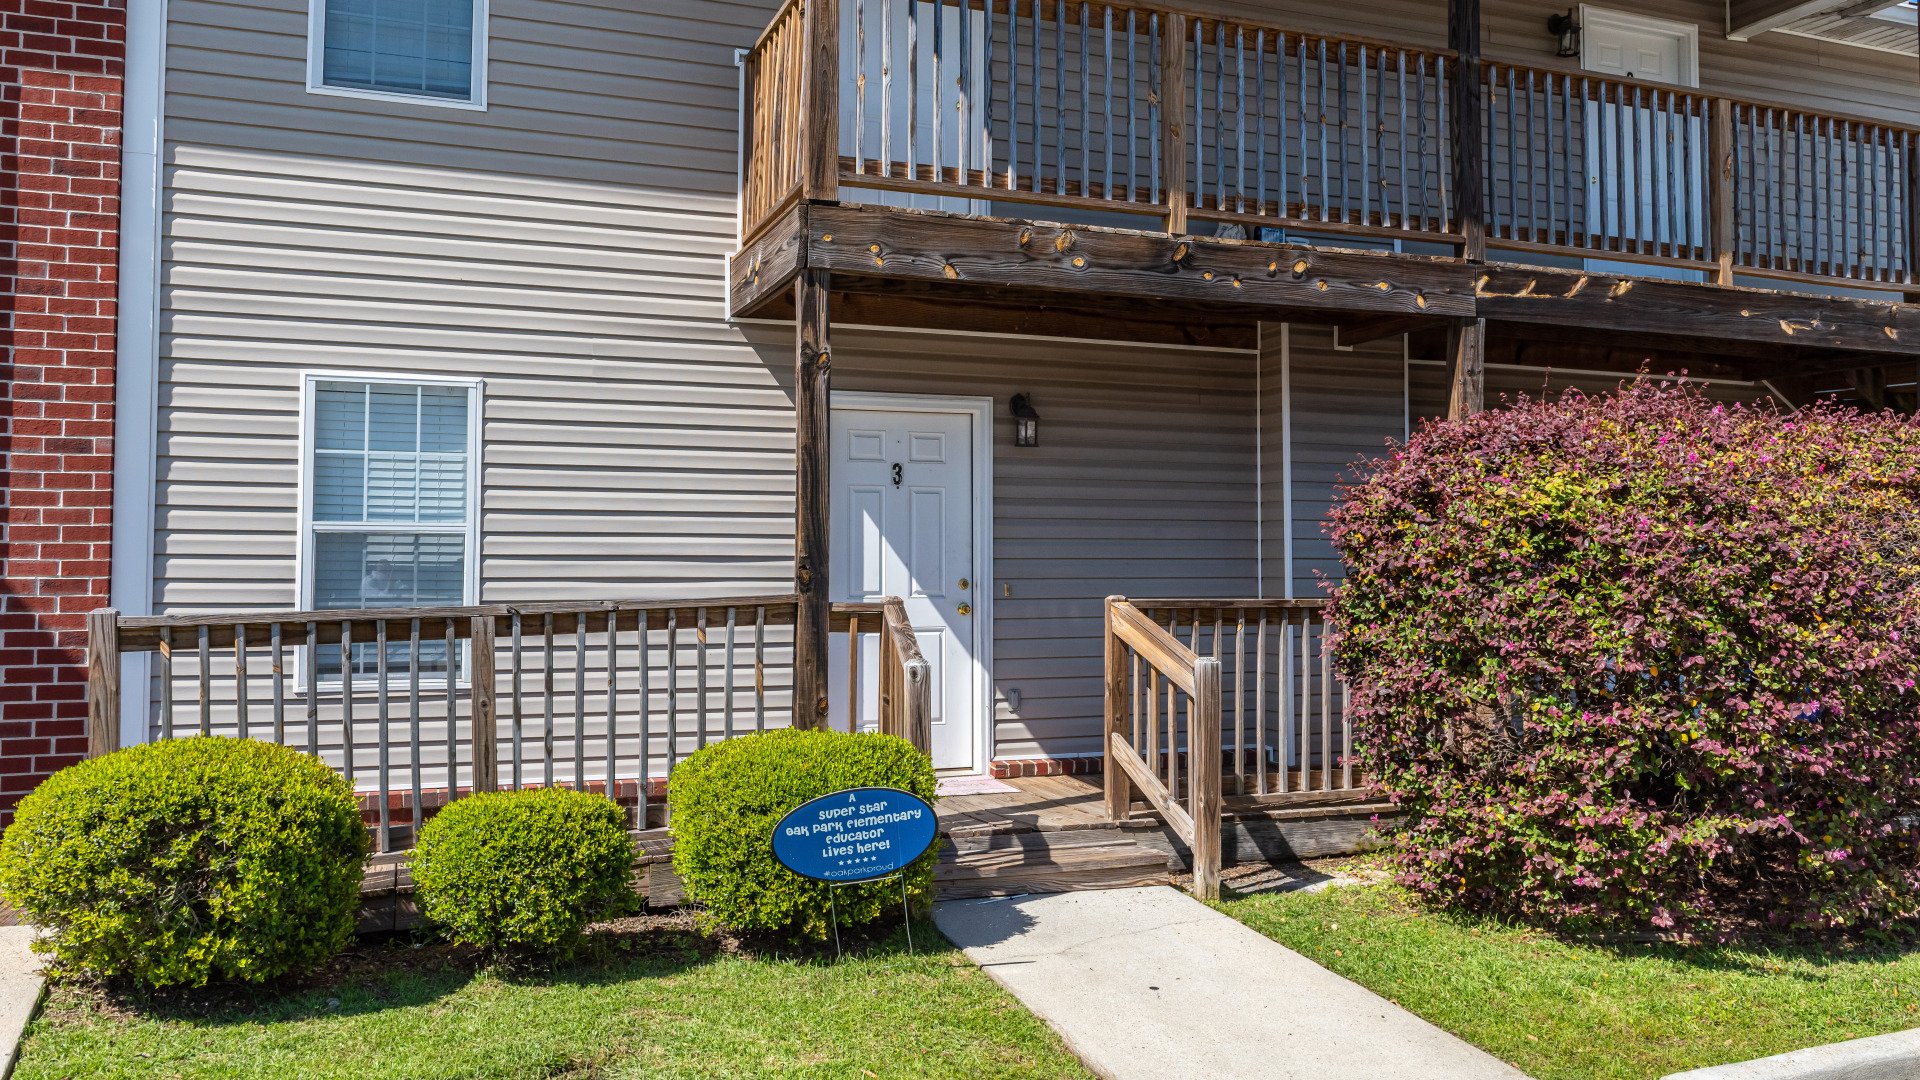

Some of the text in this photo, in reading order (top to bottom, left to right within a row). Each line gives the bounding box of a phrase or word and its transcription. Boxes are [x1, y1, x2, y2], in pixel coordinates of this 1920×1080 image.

[892, 463, 902, 485] 3
[848, 793, 856, 802] A
[857, 840, 890, 853] here!
[823, 862, 894, 877] #oakparkproud
